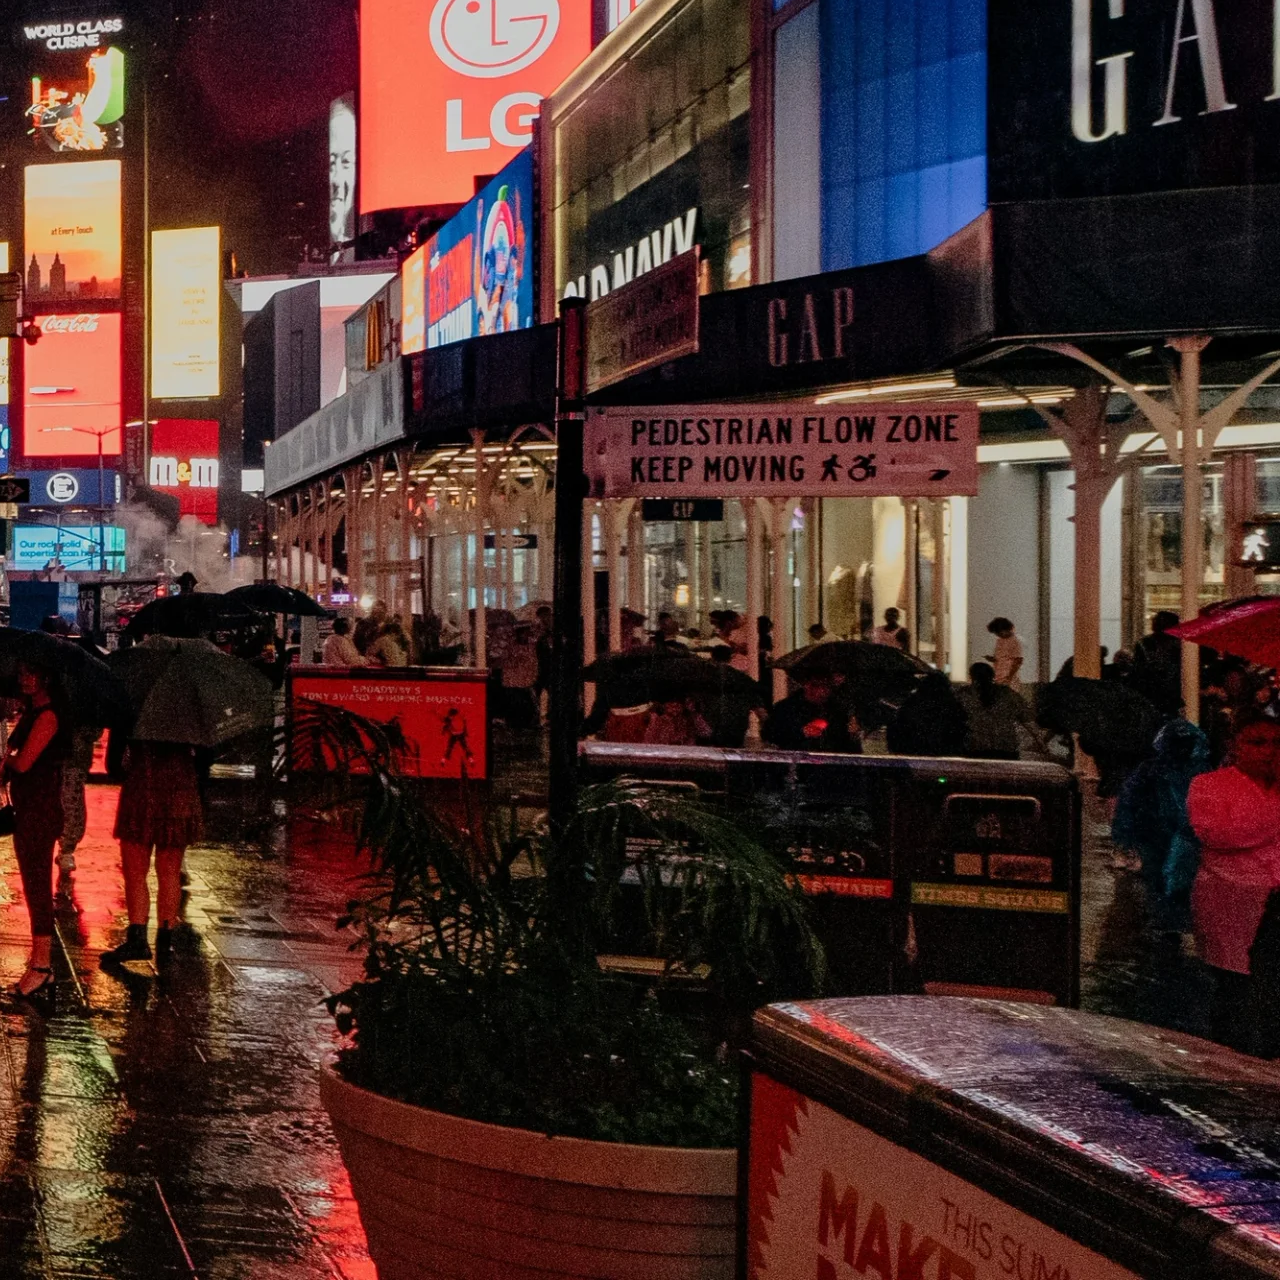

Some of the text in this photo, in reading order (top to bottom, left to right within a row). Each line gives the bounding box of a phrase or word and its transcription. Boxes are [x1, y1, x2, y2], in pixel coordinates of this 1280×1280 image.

[24, 19, 122, 39] WORLD CLASS
[46, 35, 100, 50] CUISINE
[445, 92, 545, 153] LG
[59, 226, 75, 236] Every
[76, 226, 93, 235] Touch
[612, 207, 697, 290] NAVY
[767, 287, 853, 368] GAP
[631, 414, 960, 447] PEDESTRIAN FLOW ZONE
[630, 455, 805, 483] KEEP MOVING
[20, 540, 35, 548] Our
[20, 549, 56, 558] expertis
[941, 1196, 993, 1261] THIS
